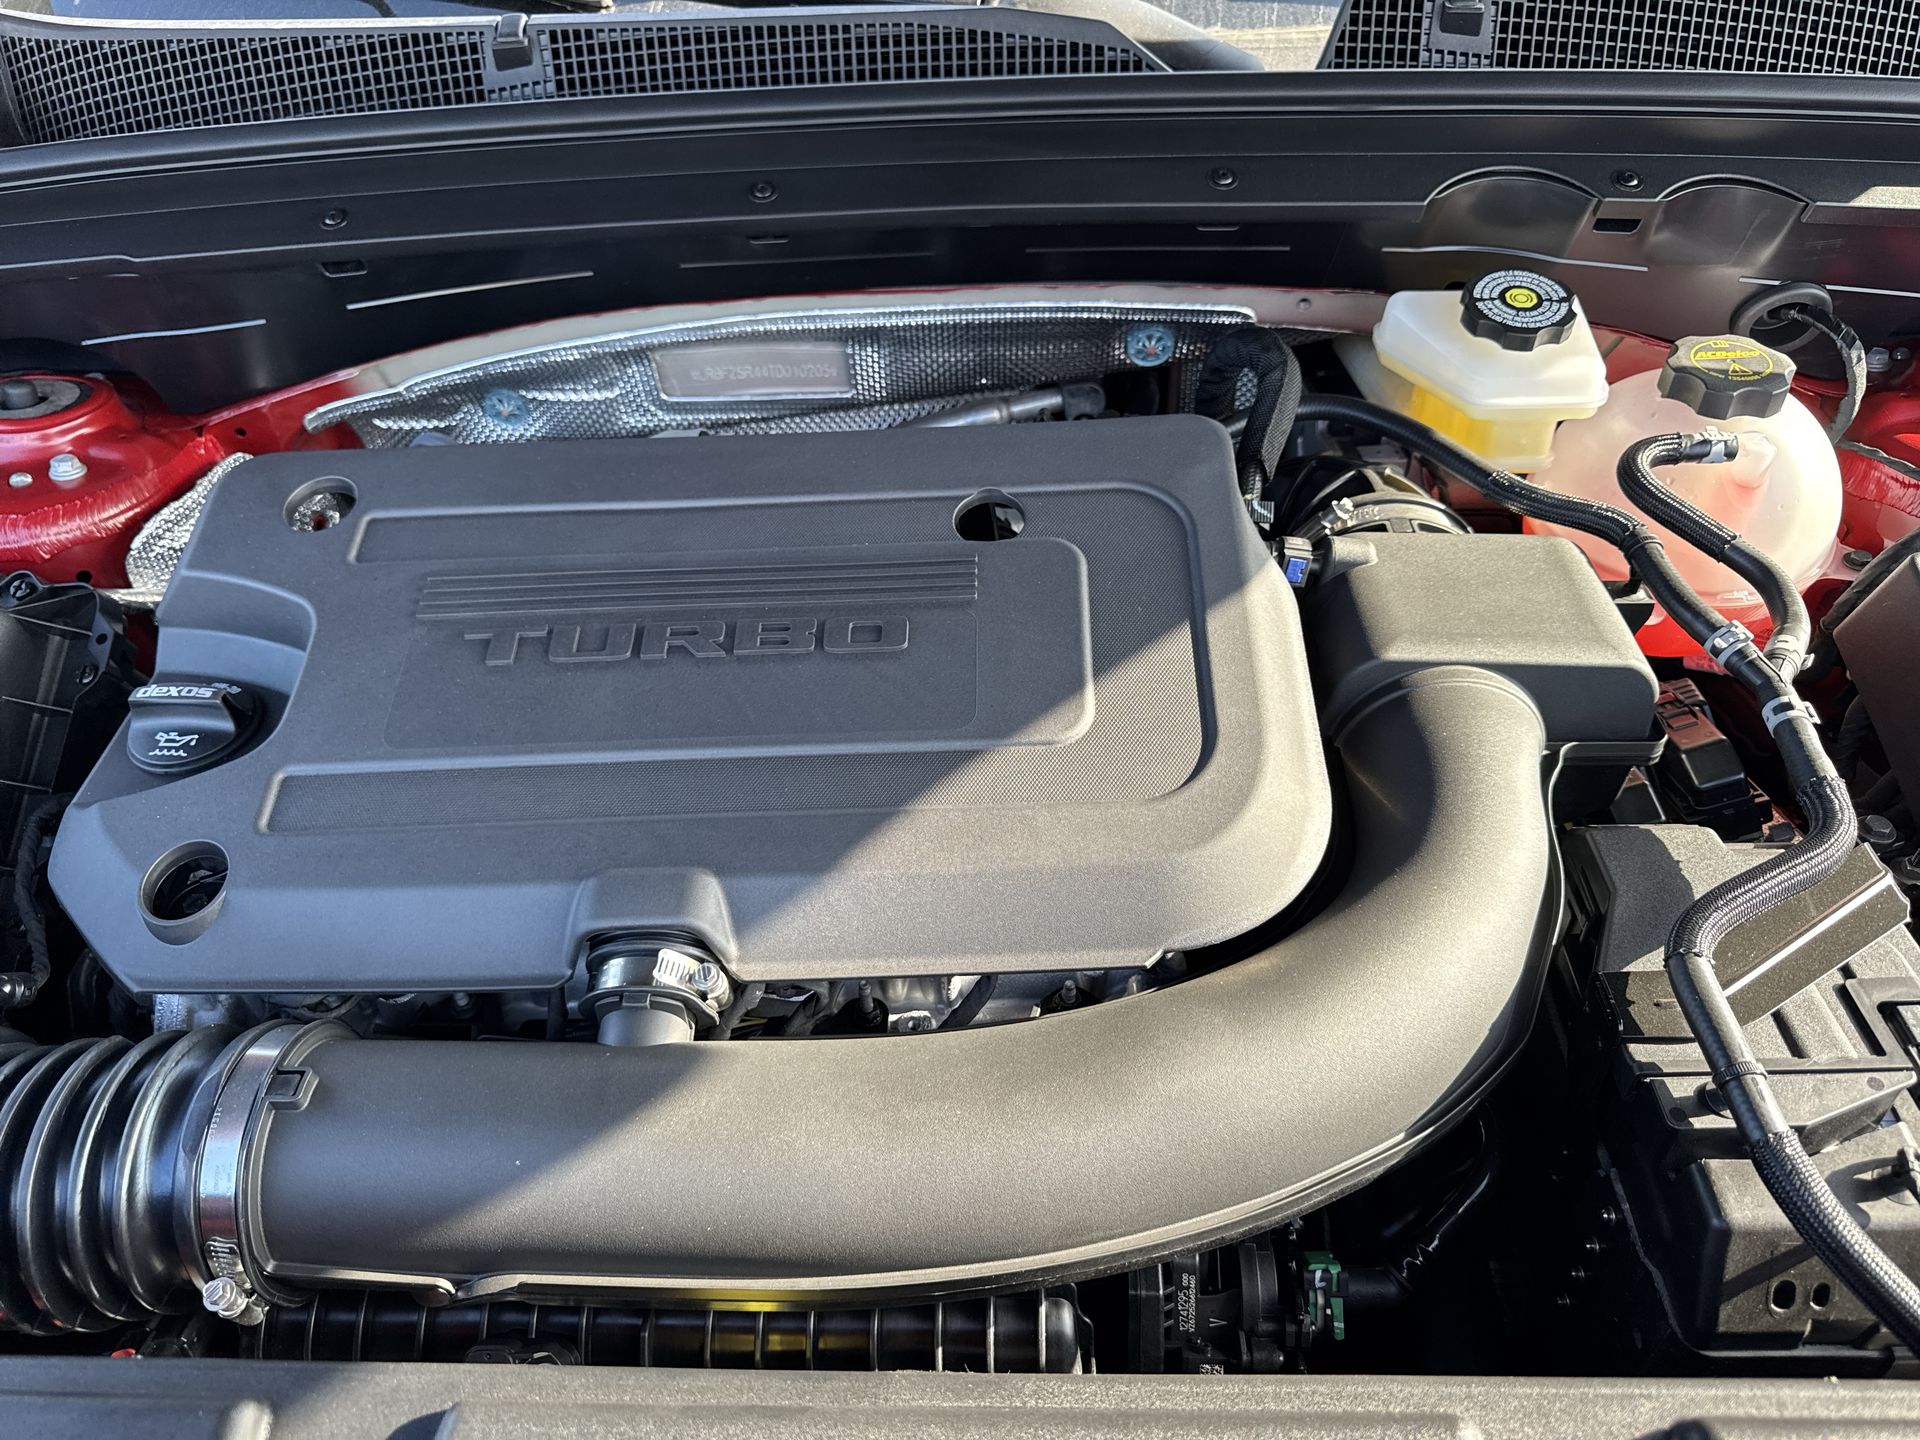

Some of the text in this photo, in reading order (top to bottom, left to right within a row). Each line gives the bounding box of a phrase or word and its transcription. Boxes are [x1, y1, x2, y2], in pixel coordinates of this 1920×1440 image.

[1695, 350, 1760, 359] ACDelco
[463, 615, 909, 666] TURBO
[136, 684, 218, 698] dexos
[1178, 1290, 1189, 1331] 12741295
